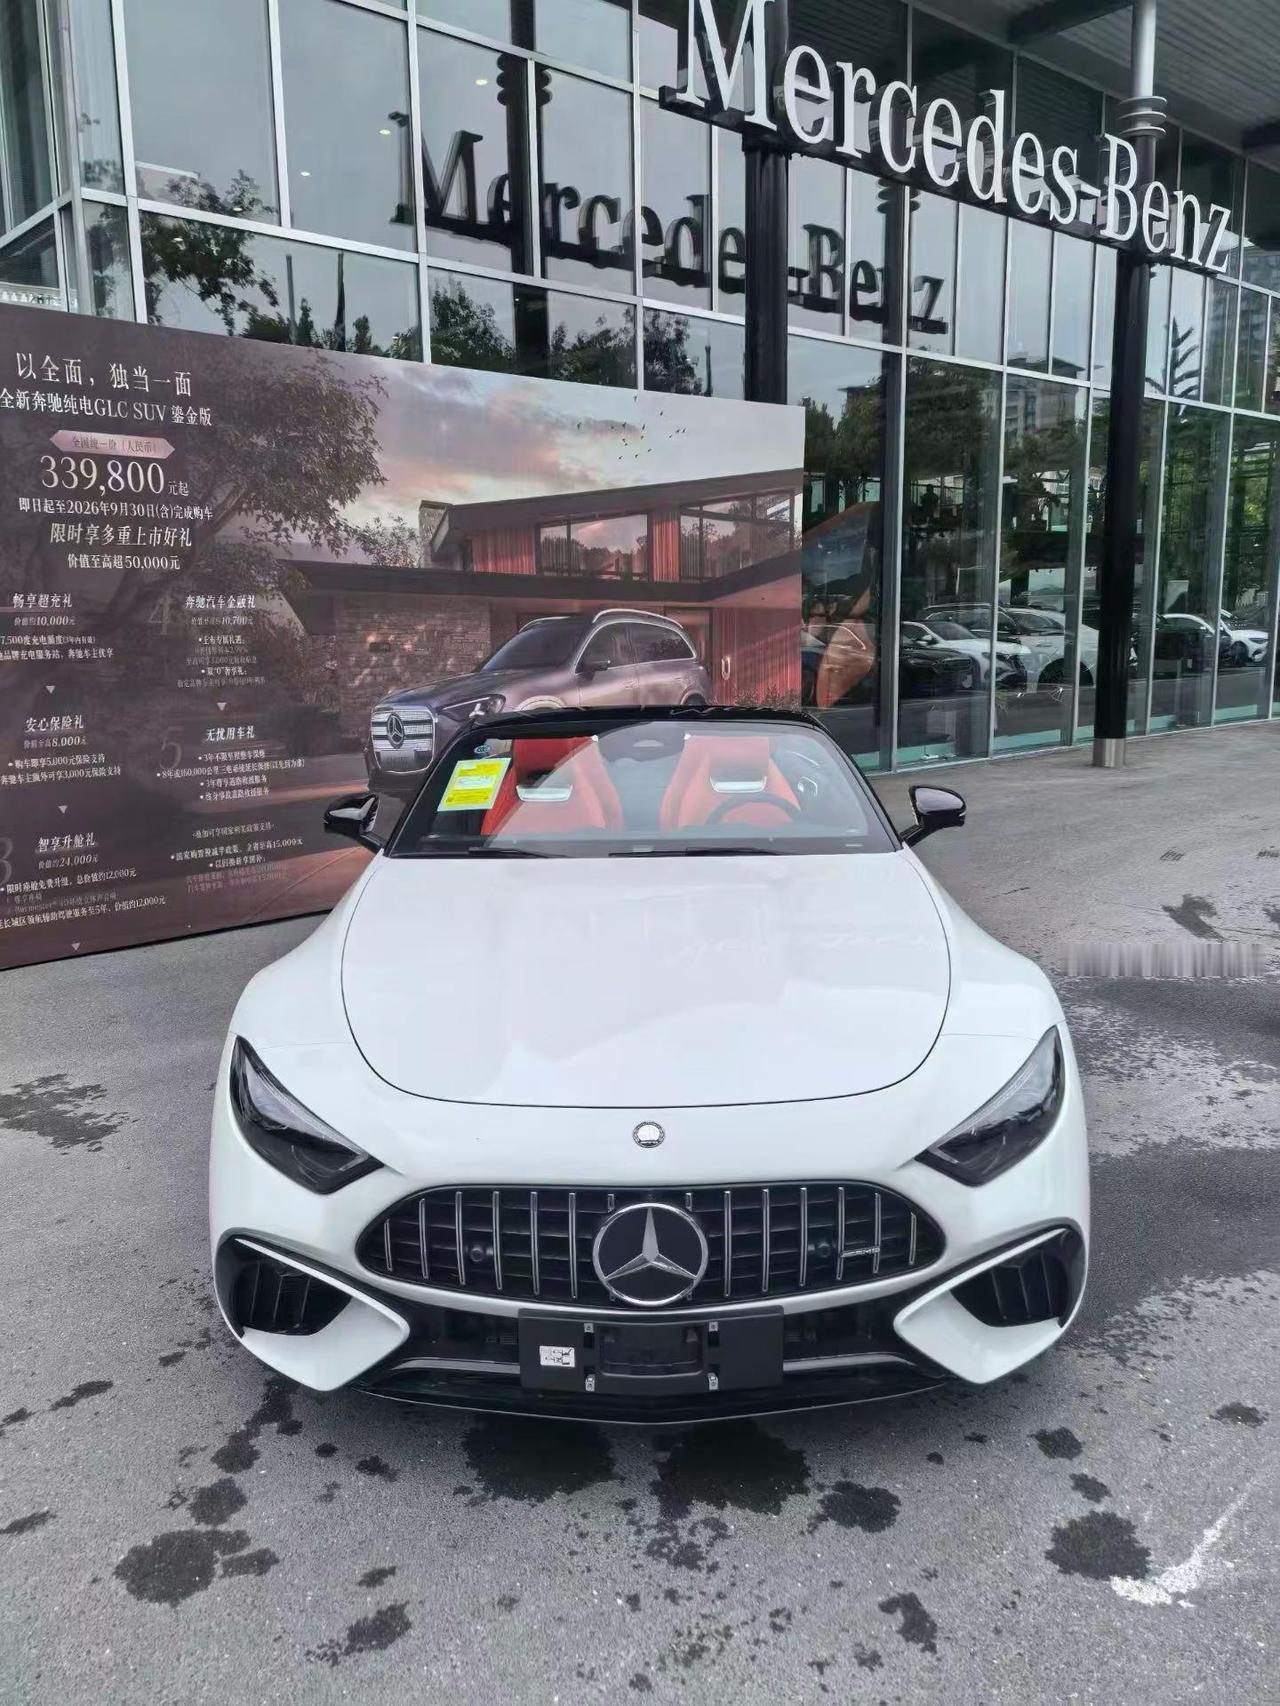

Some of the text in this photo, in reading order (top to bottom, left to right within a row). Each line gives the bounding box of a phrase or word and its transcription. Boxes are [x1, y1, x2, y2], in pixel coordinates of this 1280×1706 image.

[677, 0, 1235, 274] Mercedes-Benz
[15, 352, 192, 397] 以全面，独当一面
[0, 387, 213, 427] 全新奔驰纯电GLC SUV 鎏金版
[40, 455, 165, 496] 339,800
[50, 522, 192, 547] 限时享多重上市好礼
[67, 553, 181, 570] 价值至高超50,000元
[12, 593, 73, 609] 畅享超充礼
[185, 594, 256, 609] 奔驰汽车金融礼
[25, 714, 84, 733] 安心保险礼
[205, 725, 256, 742] 无忧用车礼
[38, 832, 97, 853] 智享升舱礼
